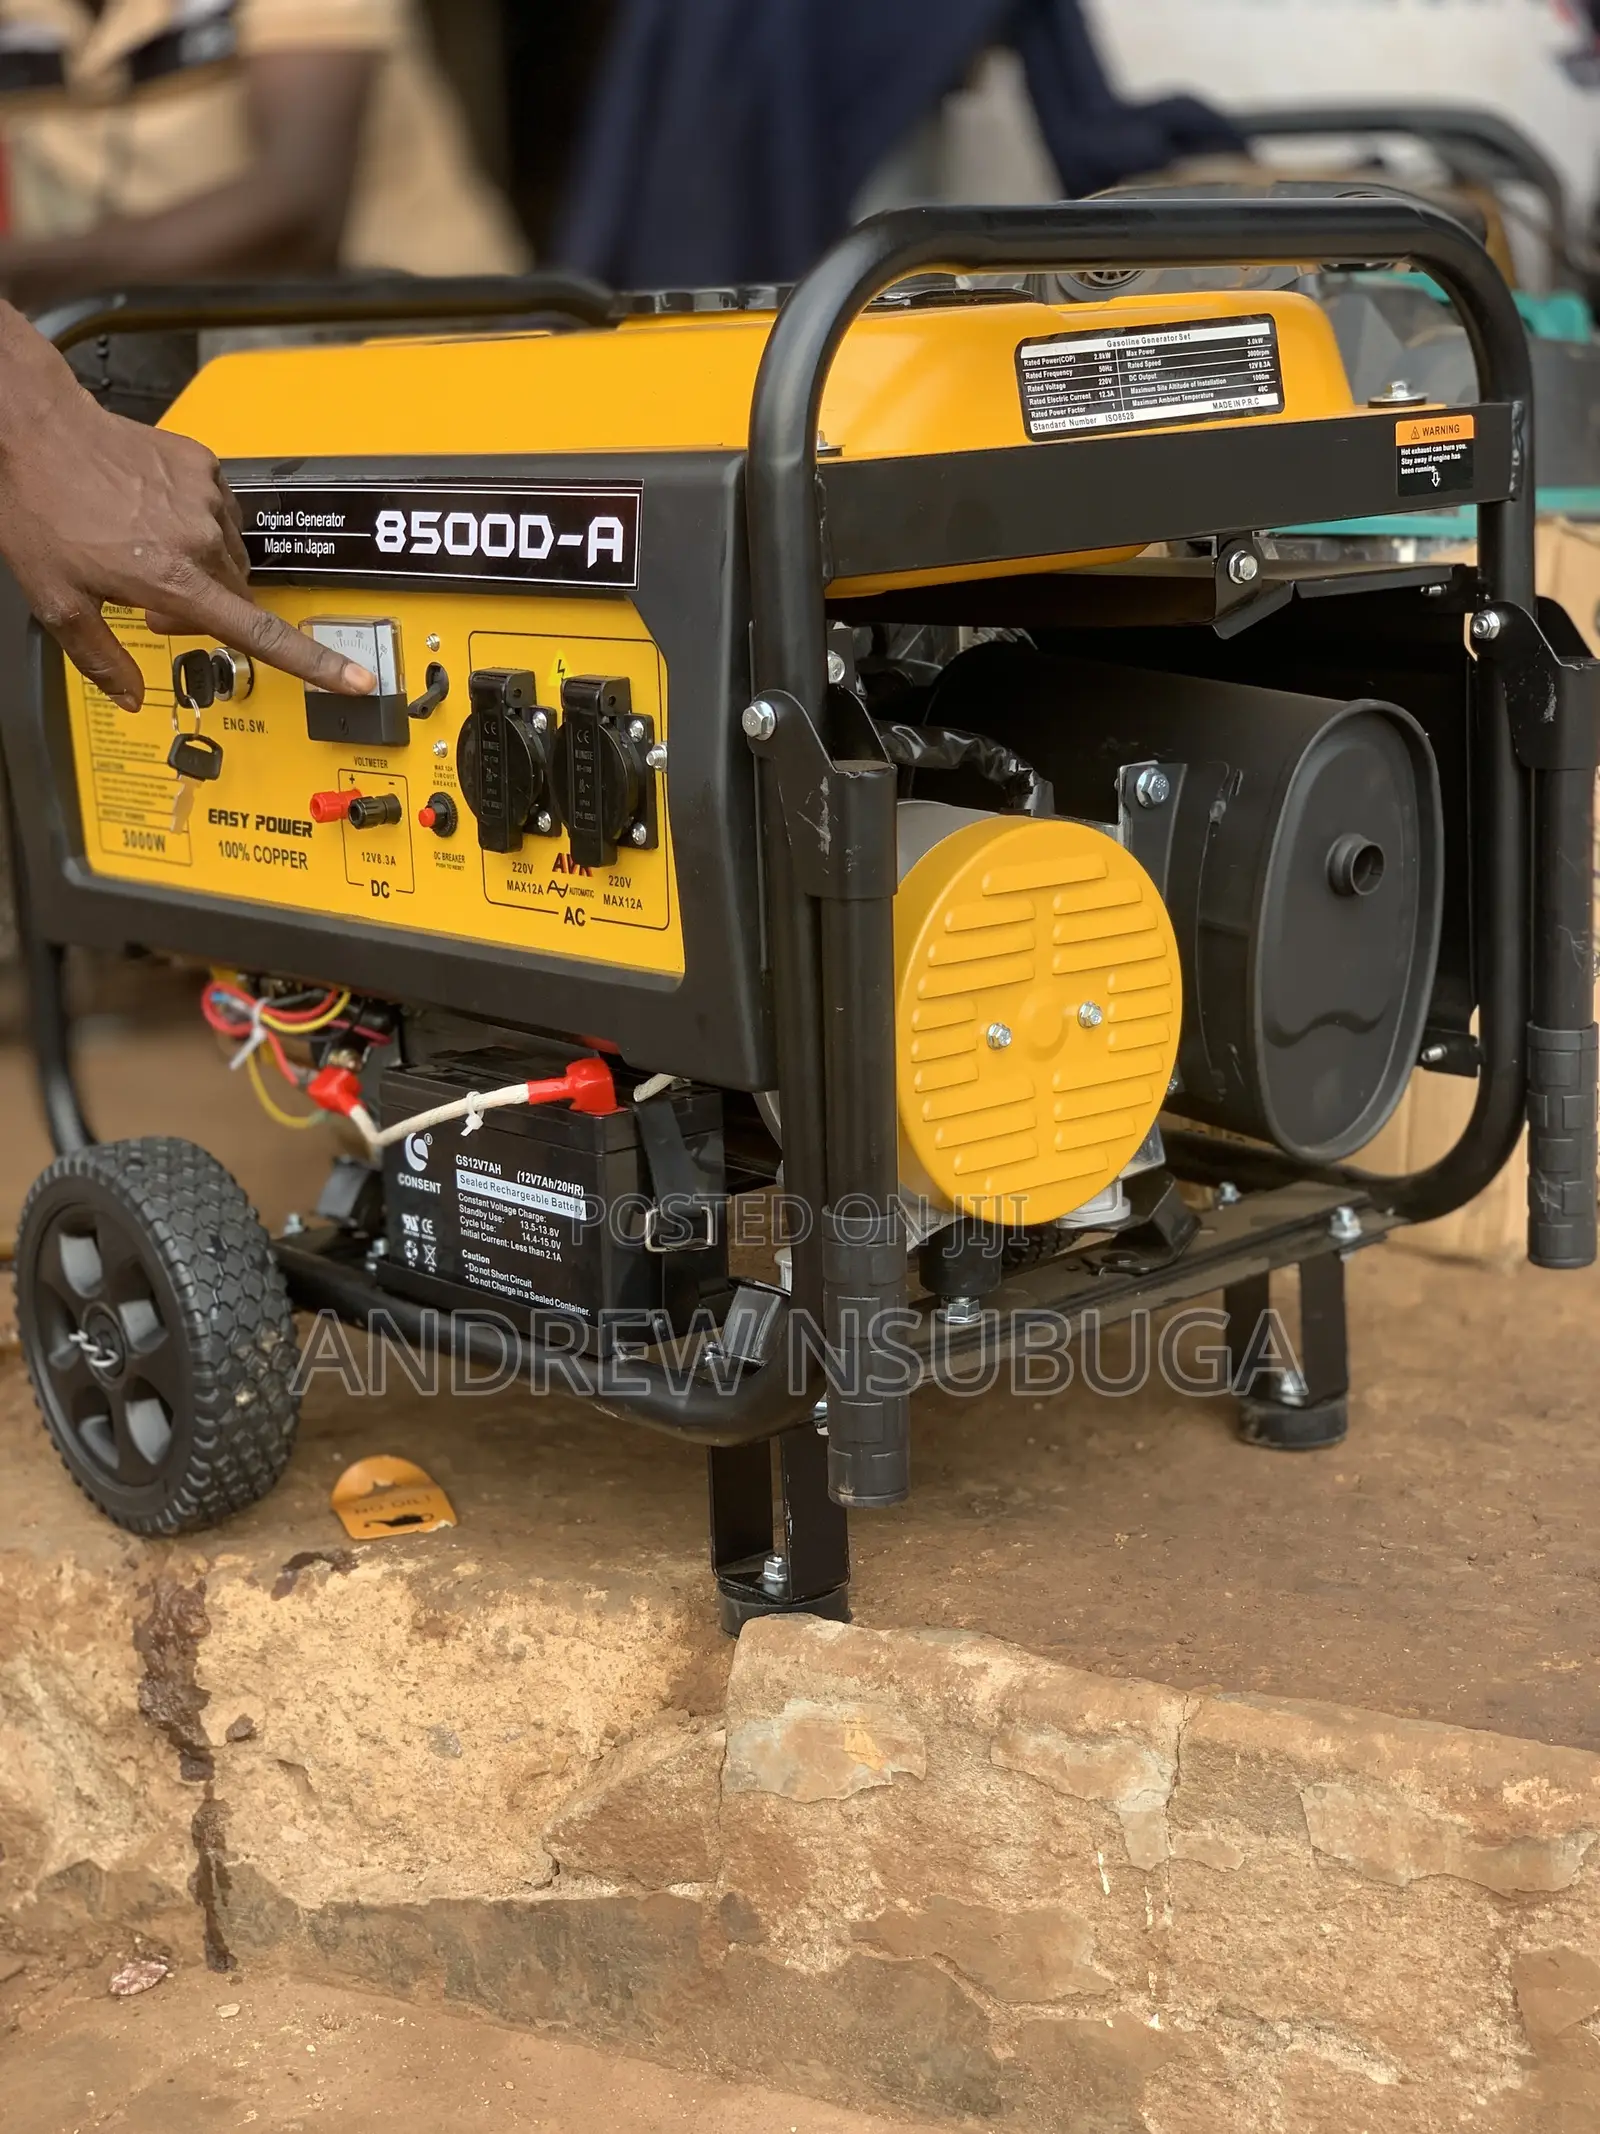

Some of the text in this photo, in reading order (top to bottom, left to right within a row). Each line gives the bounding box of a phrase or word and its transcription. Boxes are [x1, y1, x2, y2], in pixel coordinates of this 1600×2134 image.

[1106, 332, 1191, 348] Gasoline Generator Set
[1126, 349, 1138, 357] Max
[1138, 348, 1156, 356] Power
[1128, 361, 1143, 369] Rated
[1144, 360, 1162, 368] Speed
[1026, 372, 1042, 380] Rated
[1043, 369, 1073, 378] Frequency
[1138, 373, 1157, 381] Output
[1027, 384, 1044, 392] Rated
[1045, 382, 1066, 391] Voltage
[1130, 385, 1156, 394] Maximum
[1029, 397, 1046, 405] Rated
[1047, 394, 1069, 404] Electric
[1070, 393, 1091, 401] Current
[1132, 392, 1214, 407] Maximum Ambient Temperature
[1212, 401, 1233, 409] MADE
[1031, 410, 1048, 418] Rated
[1067, 406, 1086, 414] Factor
[1033, 412, 1135, 431] Standard Number ISO8528
[1422, 424, 1460, 436] WARNING
[1412, 446, 1432, 454] exhaust
[1401, 457, 1413, 466] Stay
[1433, 454, 1450, 462] engine
[256, 510, 623, 568] Original Generator 8500D-A
[264, 538, 335, 558] Made in Japan
[354, 756, 388, 768] VOLTMETER
[208, 808, 313, 838] EASY POWER
[122, 828, 166, 853] 3000W
[218, 840, 308, 870] 100% COPPER
[361, 852, 396, 866] 12V8.3A
[434, 851, 465, 863] DC BREAKER
[512, 861, 534, 875] 220V
[371, 879, 390, 899] DC
[506, 880, 544, 895] MAX12A
[608, 875, 632, 888] 220V
[569, 888, 595, 898] AUTOMATIC
[603, 893, 643, 910] MAX12A
[564, 906, 586, 927] AC
[397, 1172, 441, 1194] CONSENT
[456, 1154, 585, 1198] GS12V7AH (12V7Ah/20HR)
[460, 1174, 584, 1216] Sealed Rechargeable Battery
[458, 1192, 547, 1223] Constant Voltage Charge:
[459, 1204, 560, 1238] Standby Use: 13.5-13.8V
[460, 1215, 561, 1250] Cycle Use: 14.4-15.0V
[460, 1227, 562, 1262] Initial Current: Less than 2.1A
[462, 1249, 490, 1264] Caution
[468, 1263, 532, 1289] Do not Short Circuit
[469, 1274, 479, 1284] Do
[480, 1278, 491, 1288] not
[492, 1281, 516, 1296] Charge
[517, 1288, 524, 1297] in
[530, 1291, 554, 1306] Sealed
[555, 1299, 591, 1316] Container.
